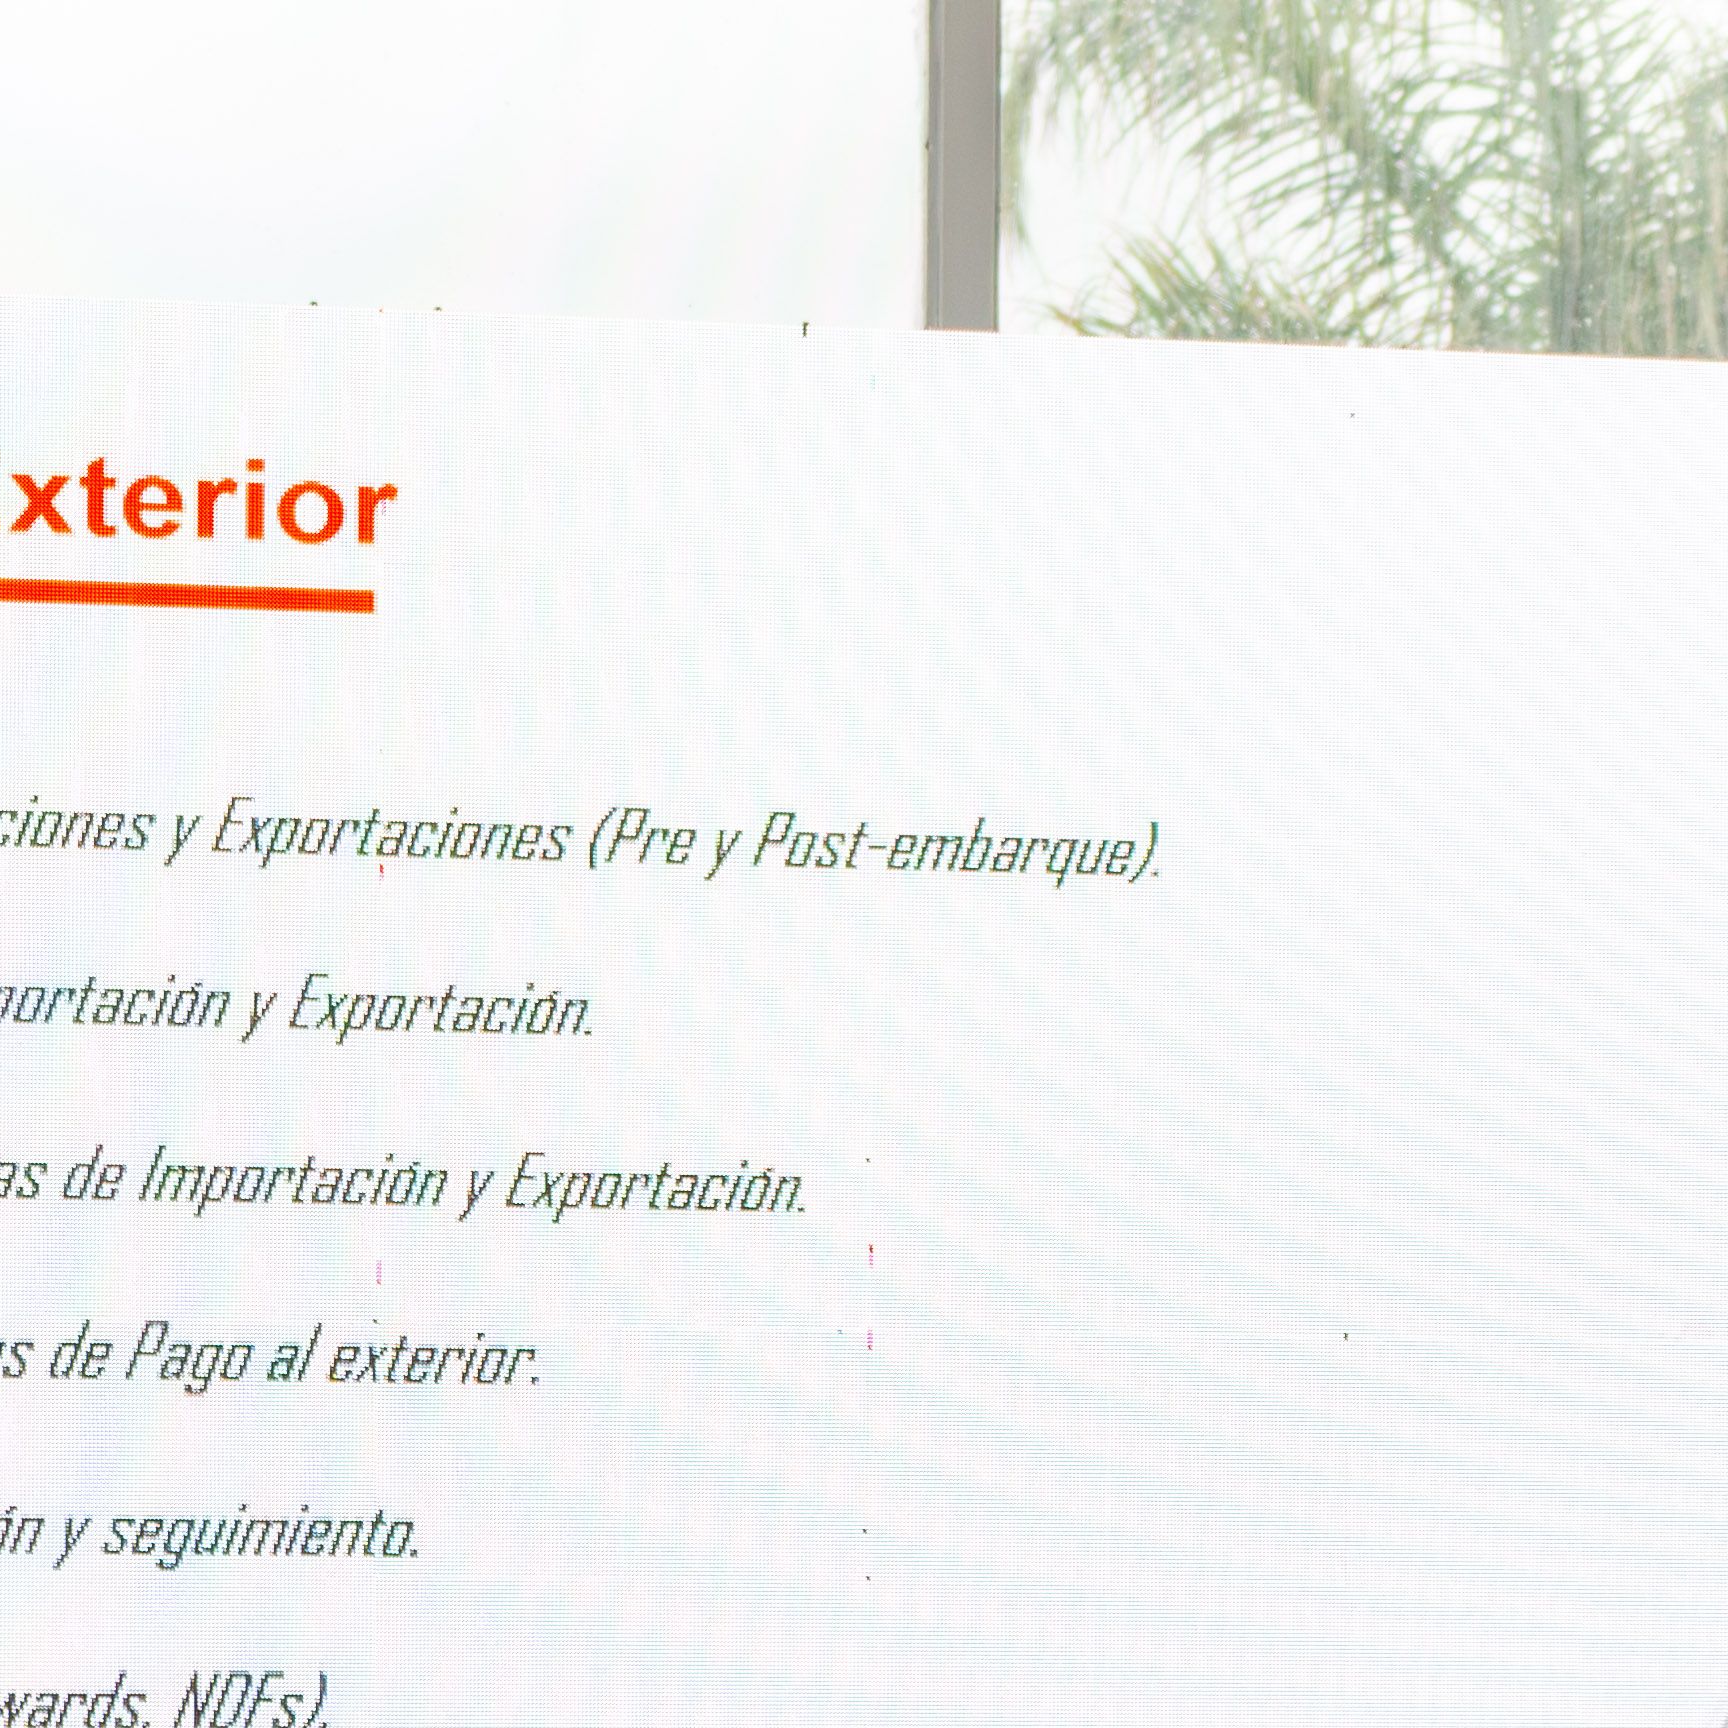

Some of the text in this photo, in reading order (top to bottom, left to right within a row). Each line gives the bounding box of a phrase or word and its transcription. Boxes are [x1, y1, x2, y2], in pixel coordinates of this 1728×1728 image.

[166, 817, 199, 865] y
[213, 798, 572, 868] Exportaciones
[589, 809, 695, 868] (Pre
[707, 832, 740, 879] y
[754, 813, 1158, 885] Post-embarque).
[243, 994, 275, 1041] y
[290, 974, 589, 1043] Exportación.
[64, 1146, 124, 1199] de
[141, 1146, 447, 1215] Importación
[460, 1172, 493, 1220] y
[507, 1153, 802, 1222] Exportación.
[51, 1322, 111, 1378] de
[127, 1322, 253, 1394] Pago
[268, 1325, 320, 1380] al
[329, 1334, 537, 1383] exterior.
[56, 1519, 90, 1567] y
[104, 1506, 416, 1569] seguimiento.
